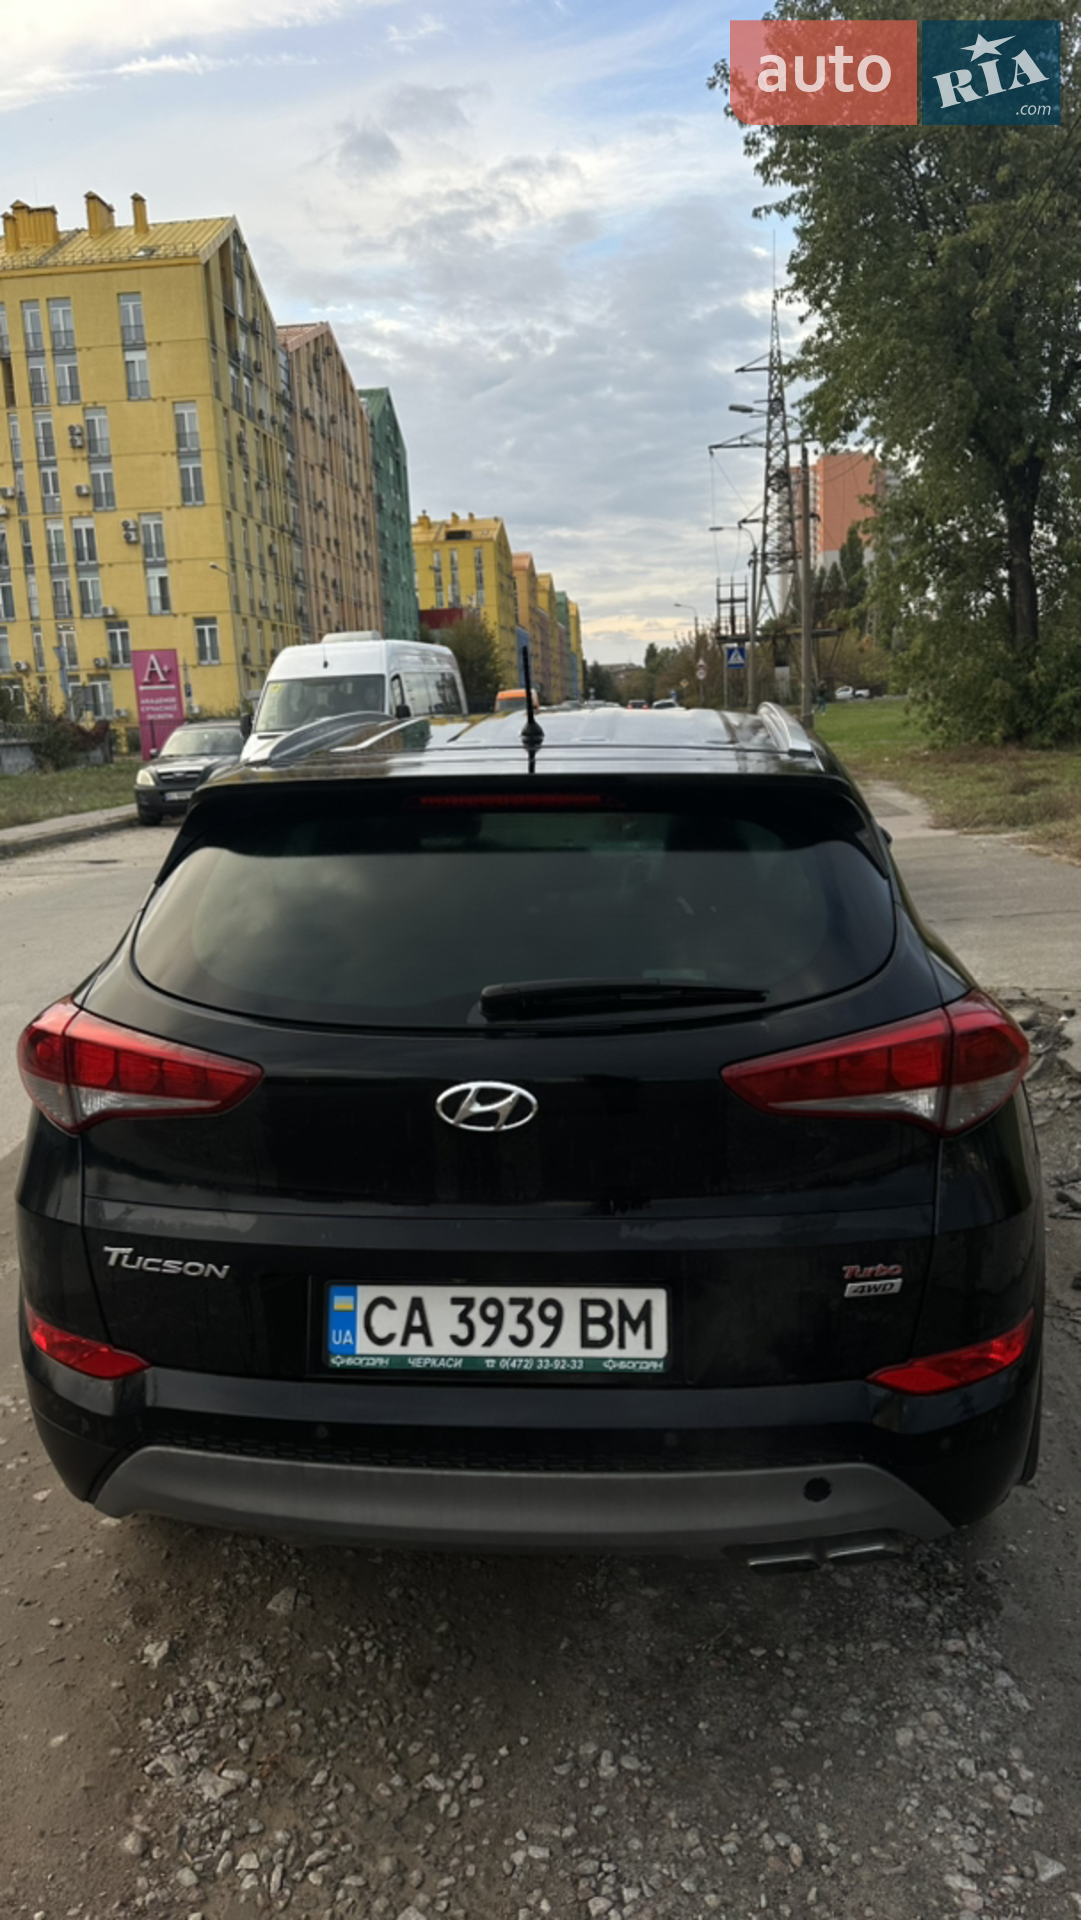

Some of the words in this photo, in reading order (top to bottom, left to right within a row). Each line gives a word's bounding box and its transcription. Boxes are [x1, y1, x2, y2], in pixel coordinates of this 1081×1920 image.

[842, 1263, 904, 1280] Turbo
[852, 1282, 896, 1295] 4WD
[363, 1295, 434, 1348] CA
[449, 1296, 564, 1349] 3939
[580, 1297, 653, 1350] BM
[331, 1329, 354, 1345] UA
[407, 1357, 463, 1369] ЧЕРКАСИ
[499, 1358, 534, 1371] 0(472)
[536, 1359, 584, 1370] 33-92-33
